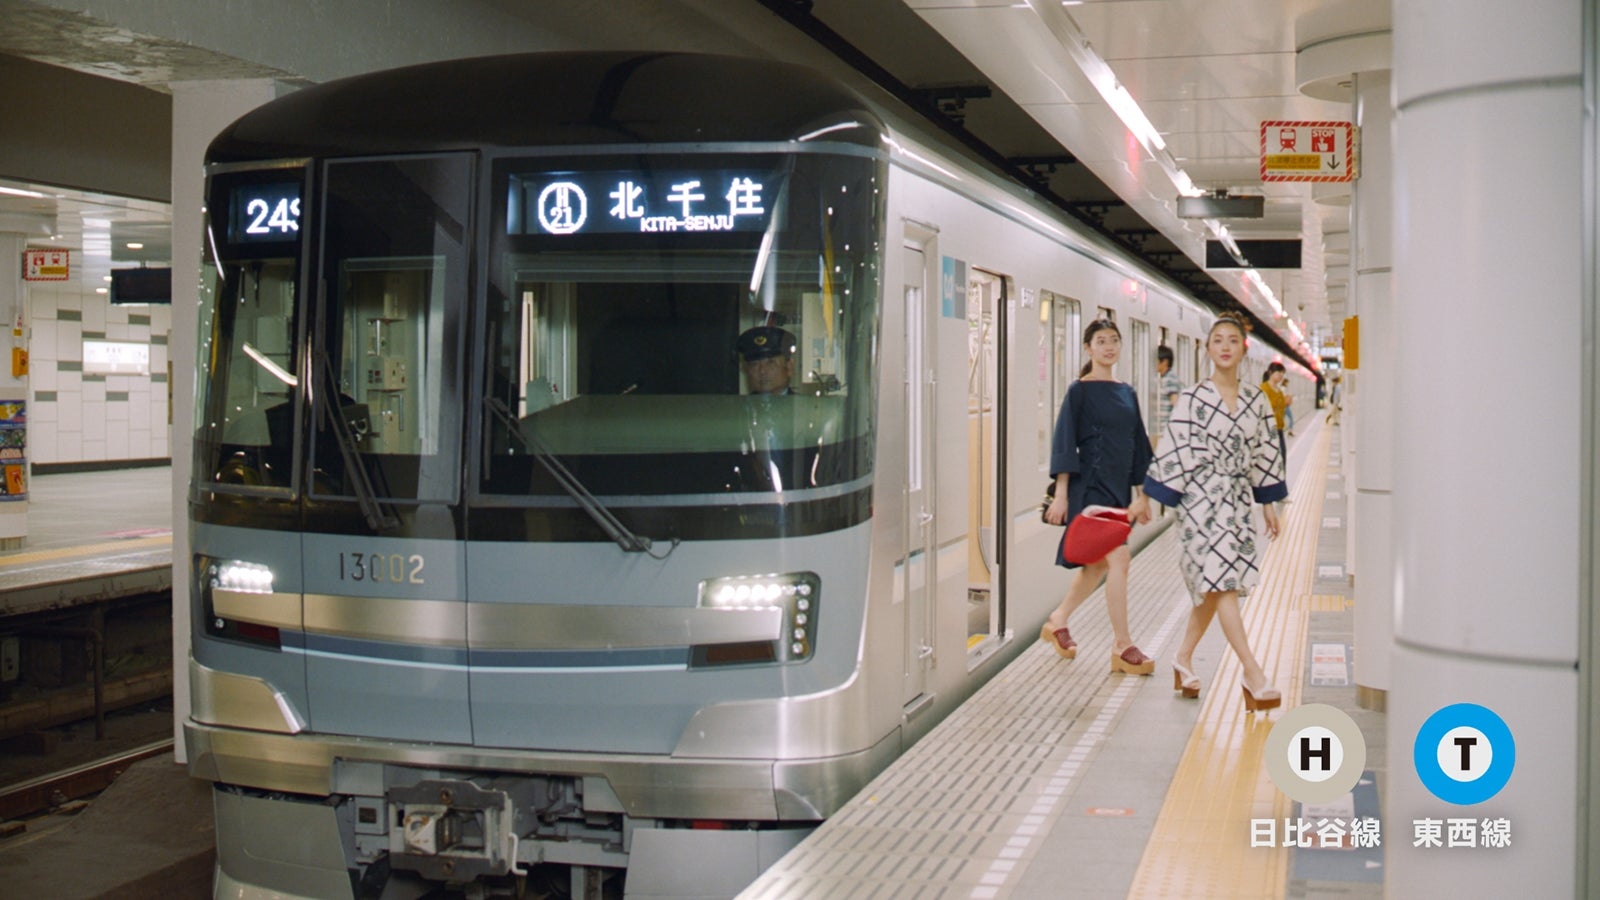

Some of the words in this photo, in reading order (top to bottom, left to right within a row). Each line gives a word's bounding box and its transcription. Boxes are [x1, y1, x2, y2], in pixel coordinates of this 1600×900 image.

[1312, 129, 1335, 138] STOP
[609, 177, 765, 219] 北千住
[550, 206, 575, 227] 21
[640, 215, 734, 232] KITA-SENJU
[339, 552, 425, 584] 13002
